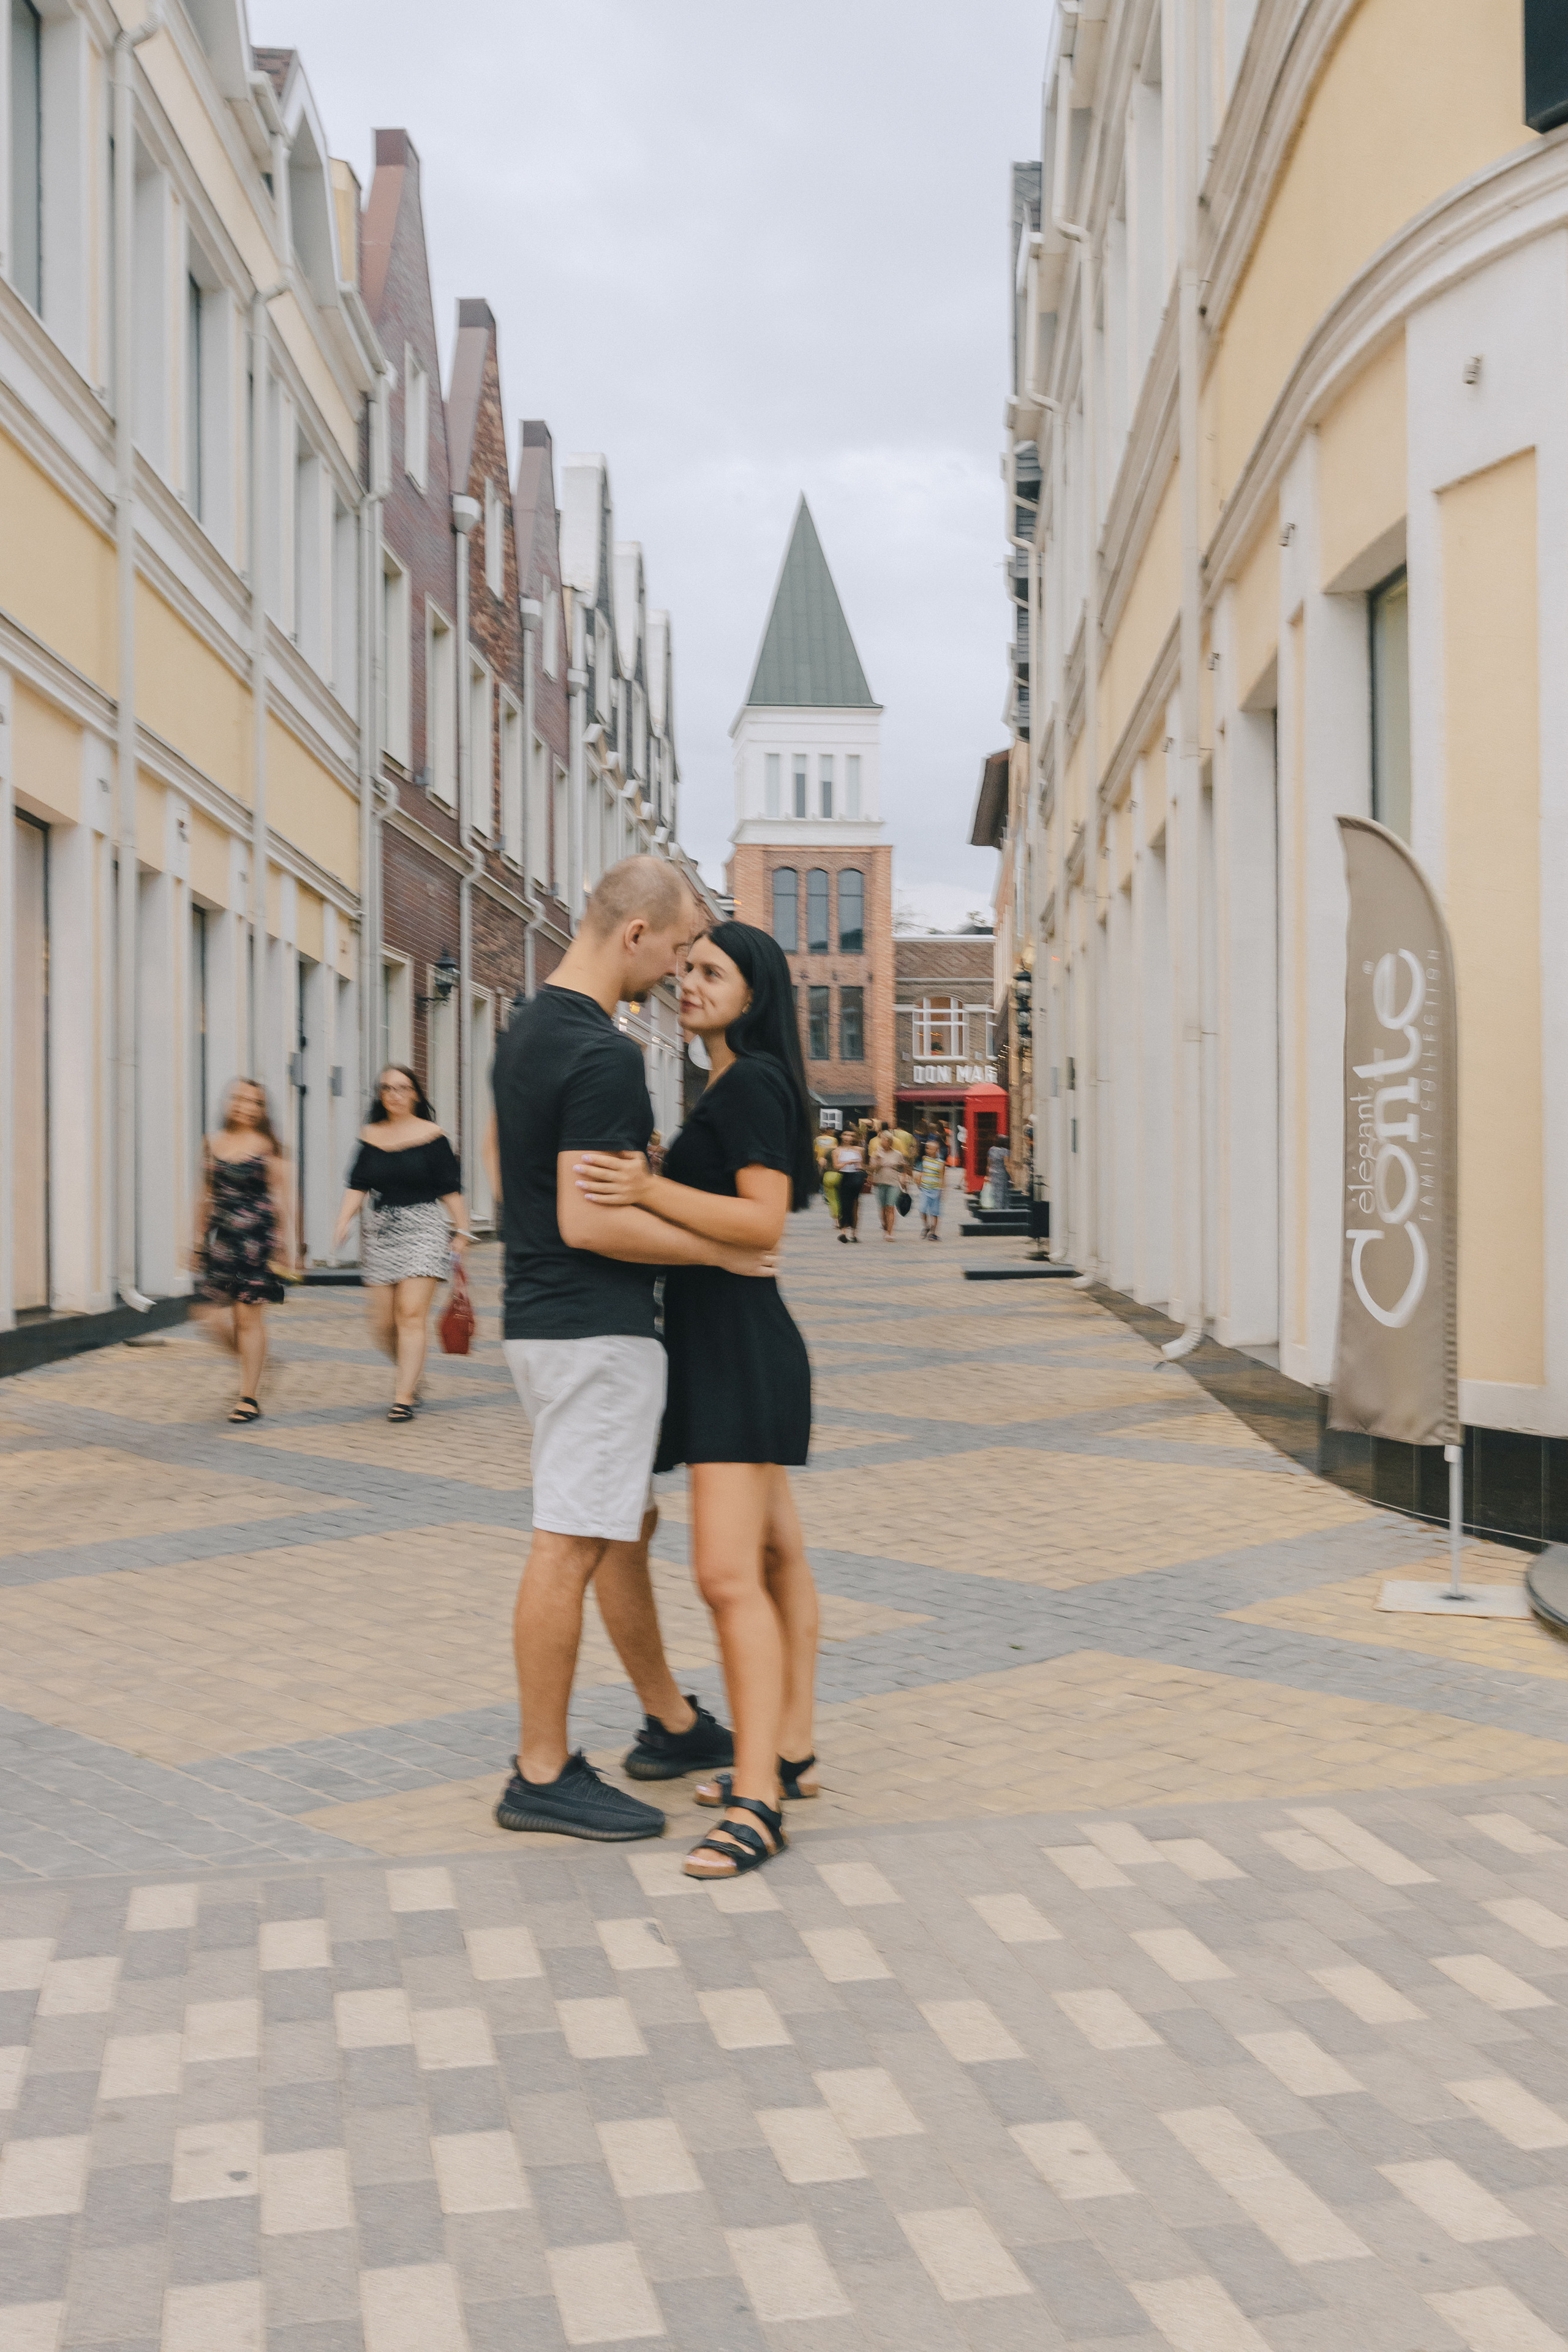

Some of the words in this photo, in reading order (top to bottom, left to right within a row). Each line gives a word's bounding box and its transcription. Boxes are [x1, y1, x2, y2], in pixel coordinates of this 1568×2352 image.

[913, 1065, 952, 1084] DON
[1420, 949, 1441, 1112] COLLECTION
[1346, 948, 1430, 1329] Conte
[1419, 1131, 1436, 1221] FAMILY
